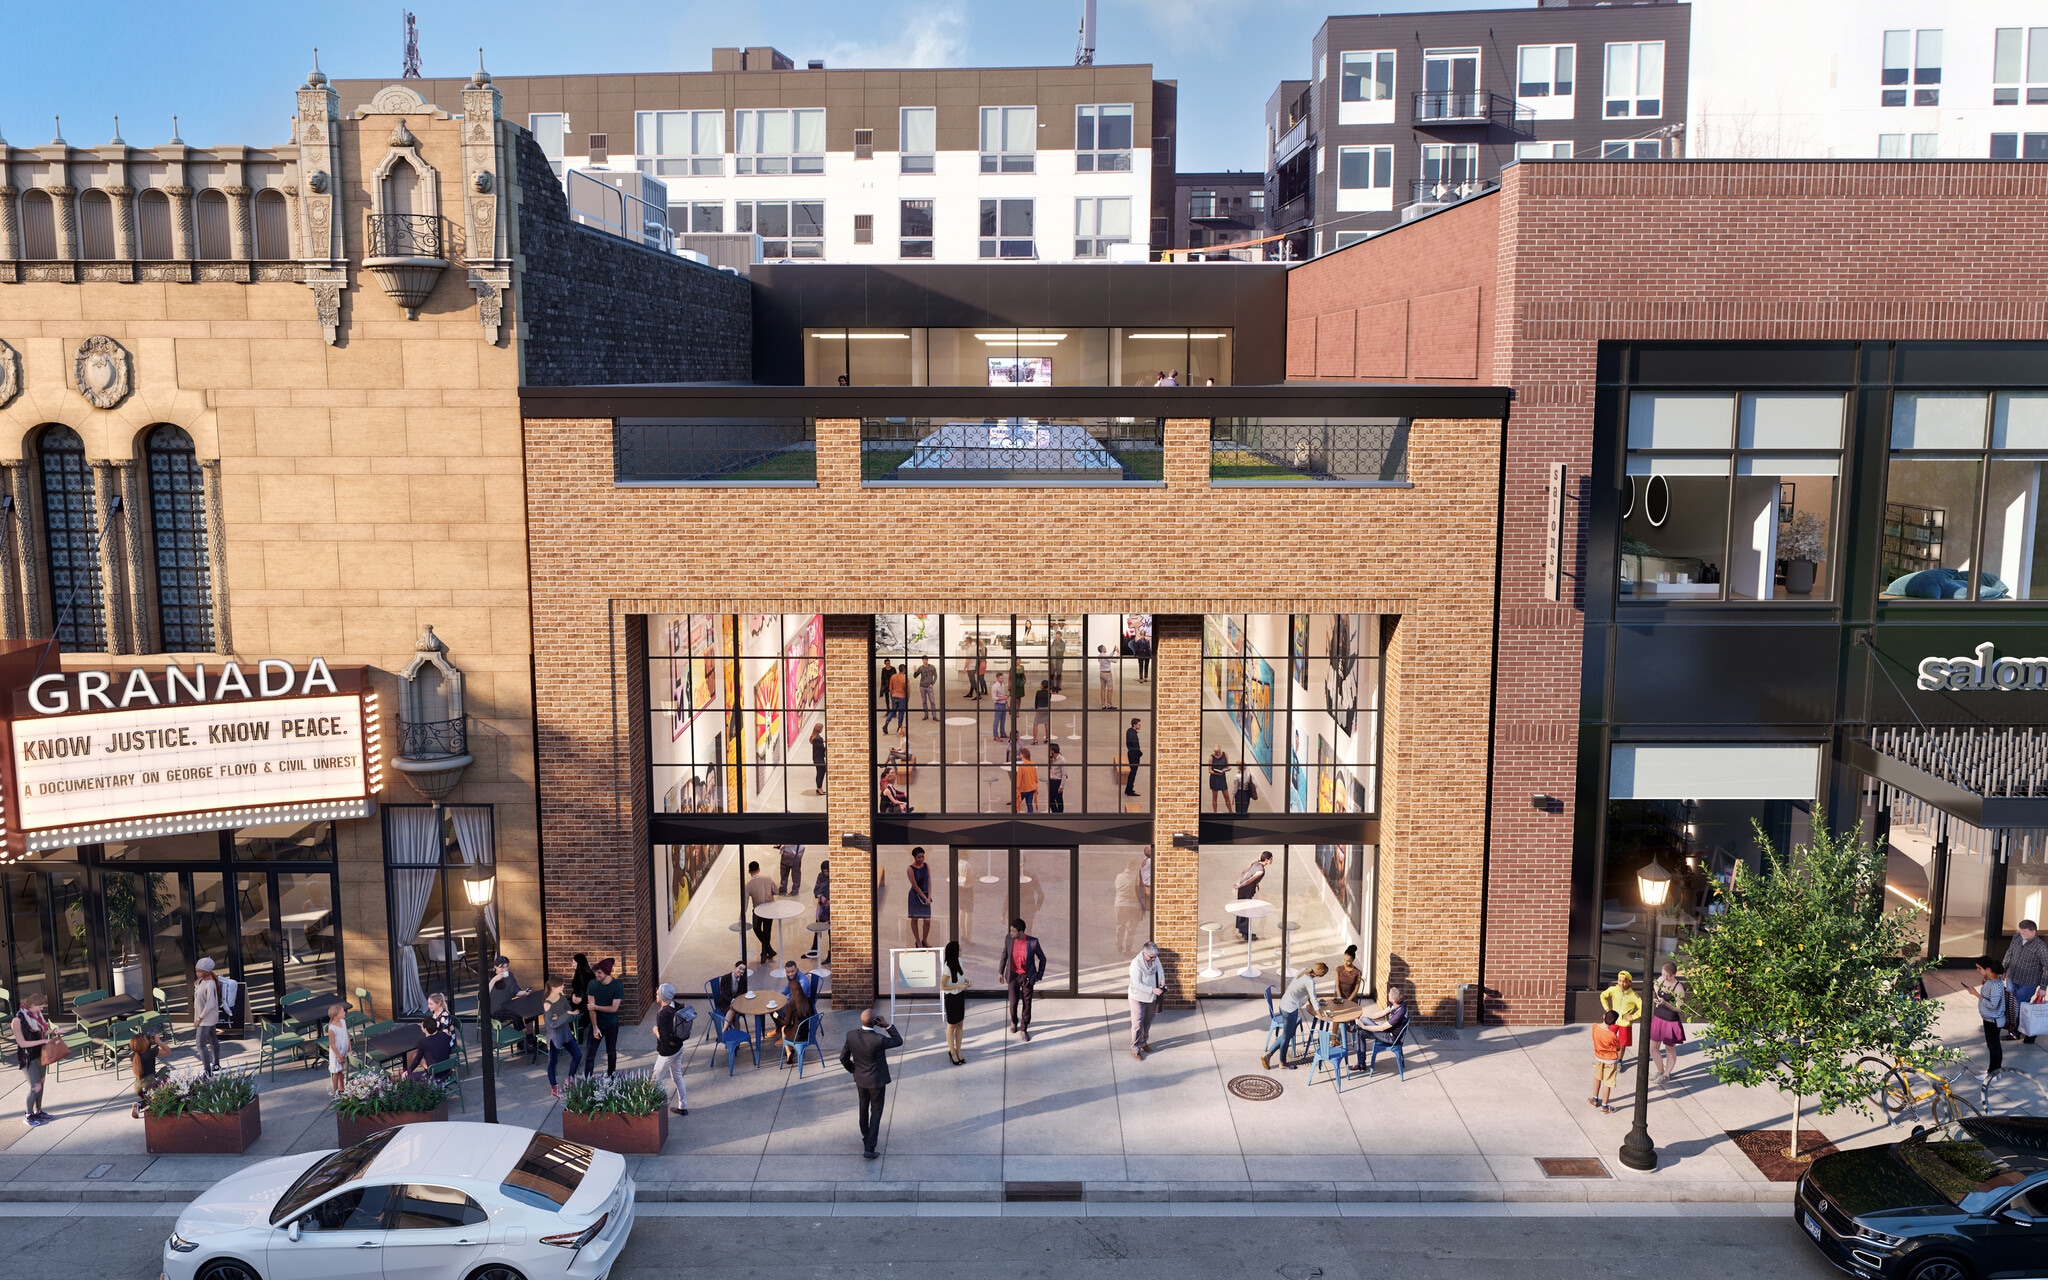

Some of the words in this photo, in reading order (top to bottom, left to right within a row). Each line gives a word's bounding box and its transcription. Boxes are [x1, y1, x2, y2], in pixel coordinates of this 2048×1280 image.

[1550, 469, 1559, 566] salons
[28, 656, 339, 714] GRANADA
[1917, 641, 2048, 690] salon
[23, 735, 91, 761] KNOW
[105, 727, 197, 753] JUSTICE.
[208, 721, 270, 744] KNOW
[281, 717, 348, 739] PEACE.
[24, 785, 32, 797] A
[40, 774, 135, 795] DOCUMENTARY
[142, 772, 160, 784] ON
[167, 767, 213, 781] GEORGE
[220, 763, 257, 777] FLOYD
[264, 762, 272, 773] &
[279, 760, 307, 772] CIVIL
[313, 756, 357, 769] UNREST
